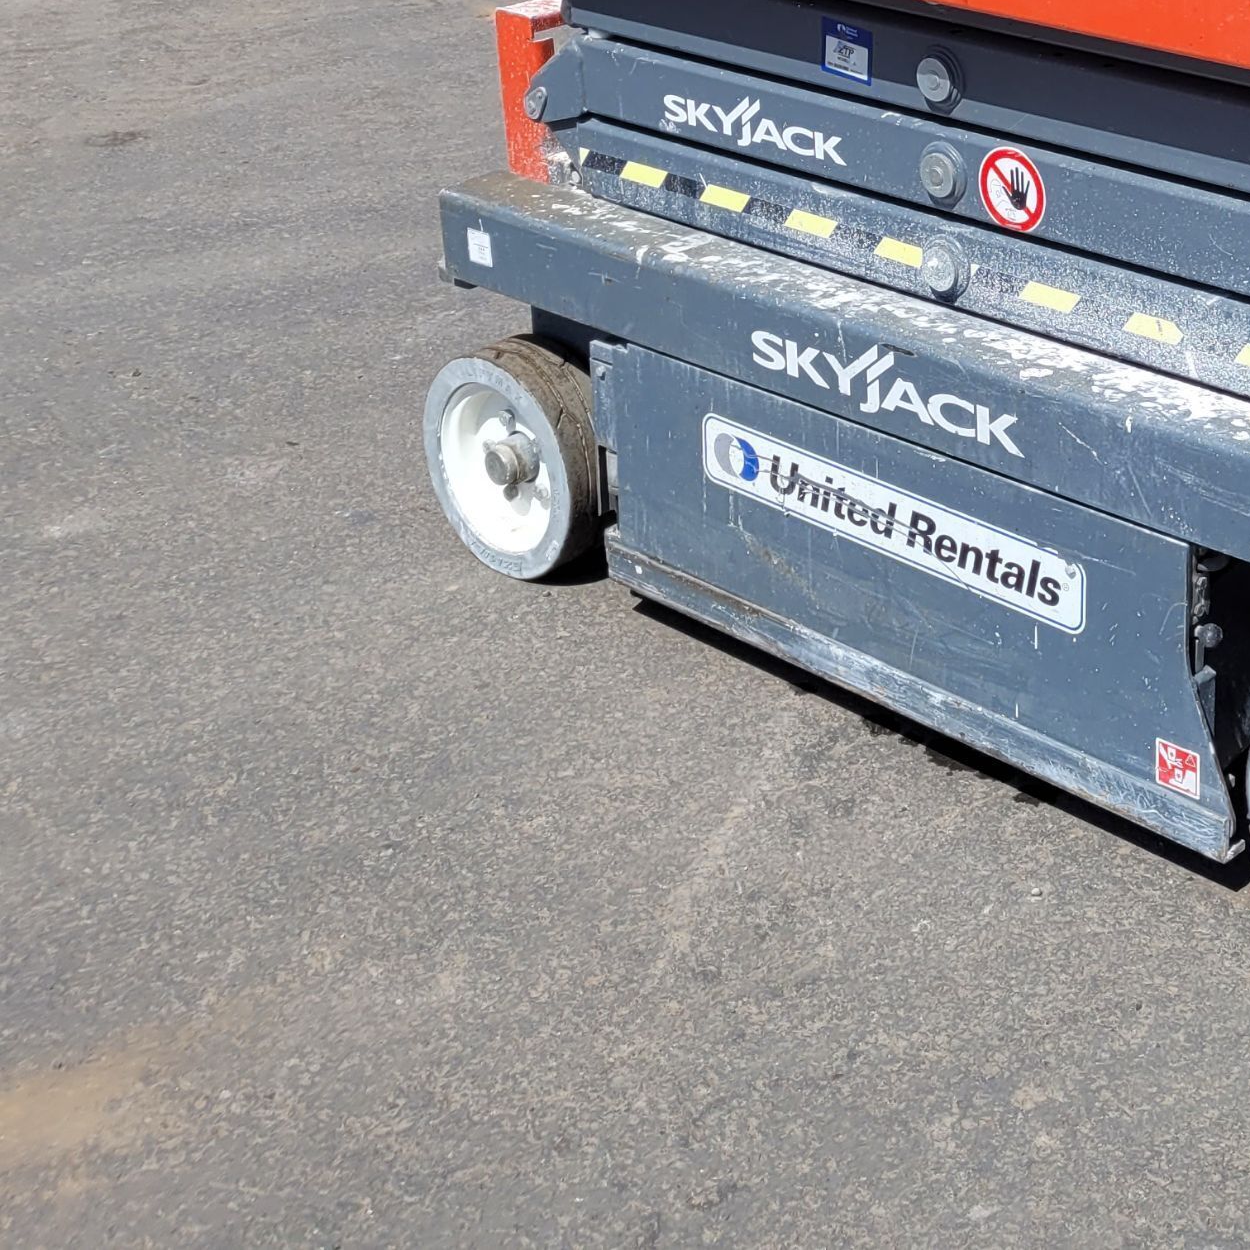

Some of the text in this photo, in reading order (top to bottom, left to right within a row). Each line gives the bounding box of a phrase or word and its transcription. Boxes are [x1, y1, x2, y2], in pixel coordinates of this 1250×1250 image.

[663, 93, 848, 167] SKYJACK
[750, 330, 1026, 458] SKYJACK
[768, 454, 1063, 607] United Rentals
